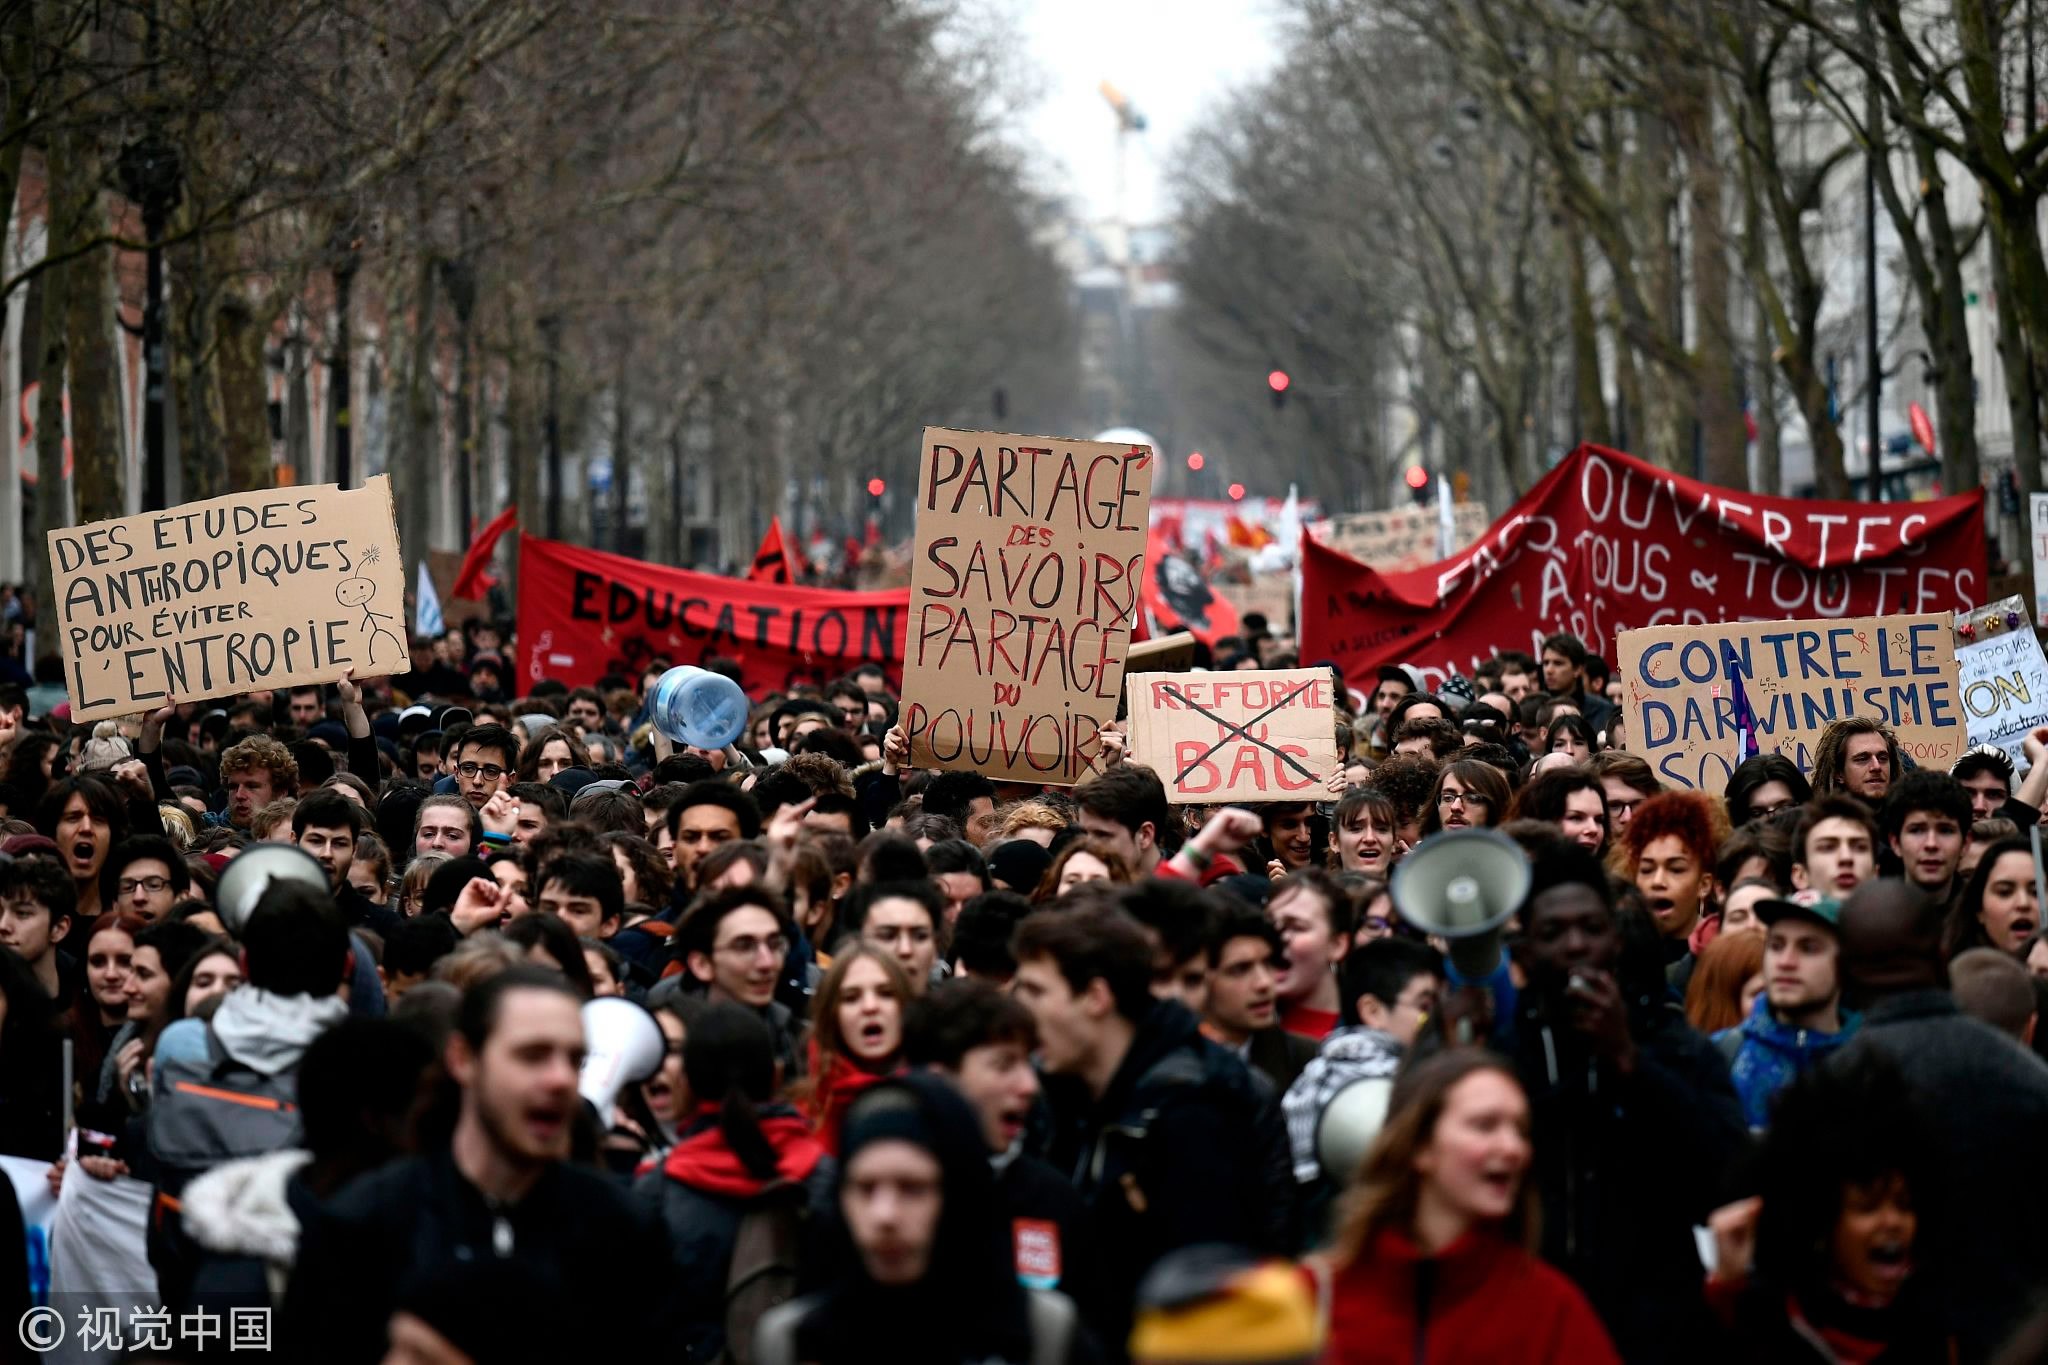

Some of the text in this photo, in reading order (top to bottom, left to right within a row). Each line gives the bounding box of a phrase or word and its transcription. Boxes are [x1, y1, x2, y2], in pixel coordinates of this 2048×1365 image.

[55, 499, 318, 573] DES ÉTUDES
[1006, 524, 1055, 548] DES
[65, 539, 353, 622] ANTHROPiQUES
[922, 536, 1144, 623] SAVOiRS
[1574, 530, 1671, 602] TOUS
[1690, 569, 1718, 596] &
[1732, 552, 1974, 617] TOUTES
[70, 601, 254, 658] POUR ÉViTER
[571, 570, 896, 661] EDUCATION
[75, 619, 353, 711] L'ENTROPiE
[918, 604, 1126, 699] PARTAGE
[1639, 627, 1863, 689] CONTRE
[1876, 623, 1941, 678] LE
[993, 683, 1022, 708] DU
[1151, 679, 1331, 710] REFORME
[1641, 681, 1957, 749] DARWINISME
[1962, 670, 2032, 723] ON
[1218, 721, 1269, 743] DU
[1901, 735, 1960, 760] RONS!
[1174, 740, 1321, 794] BAC
